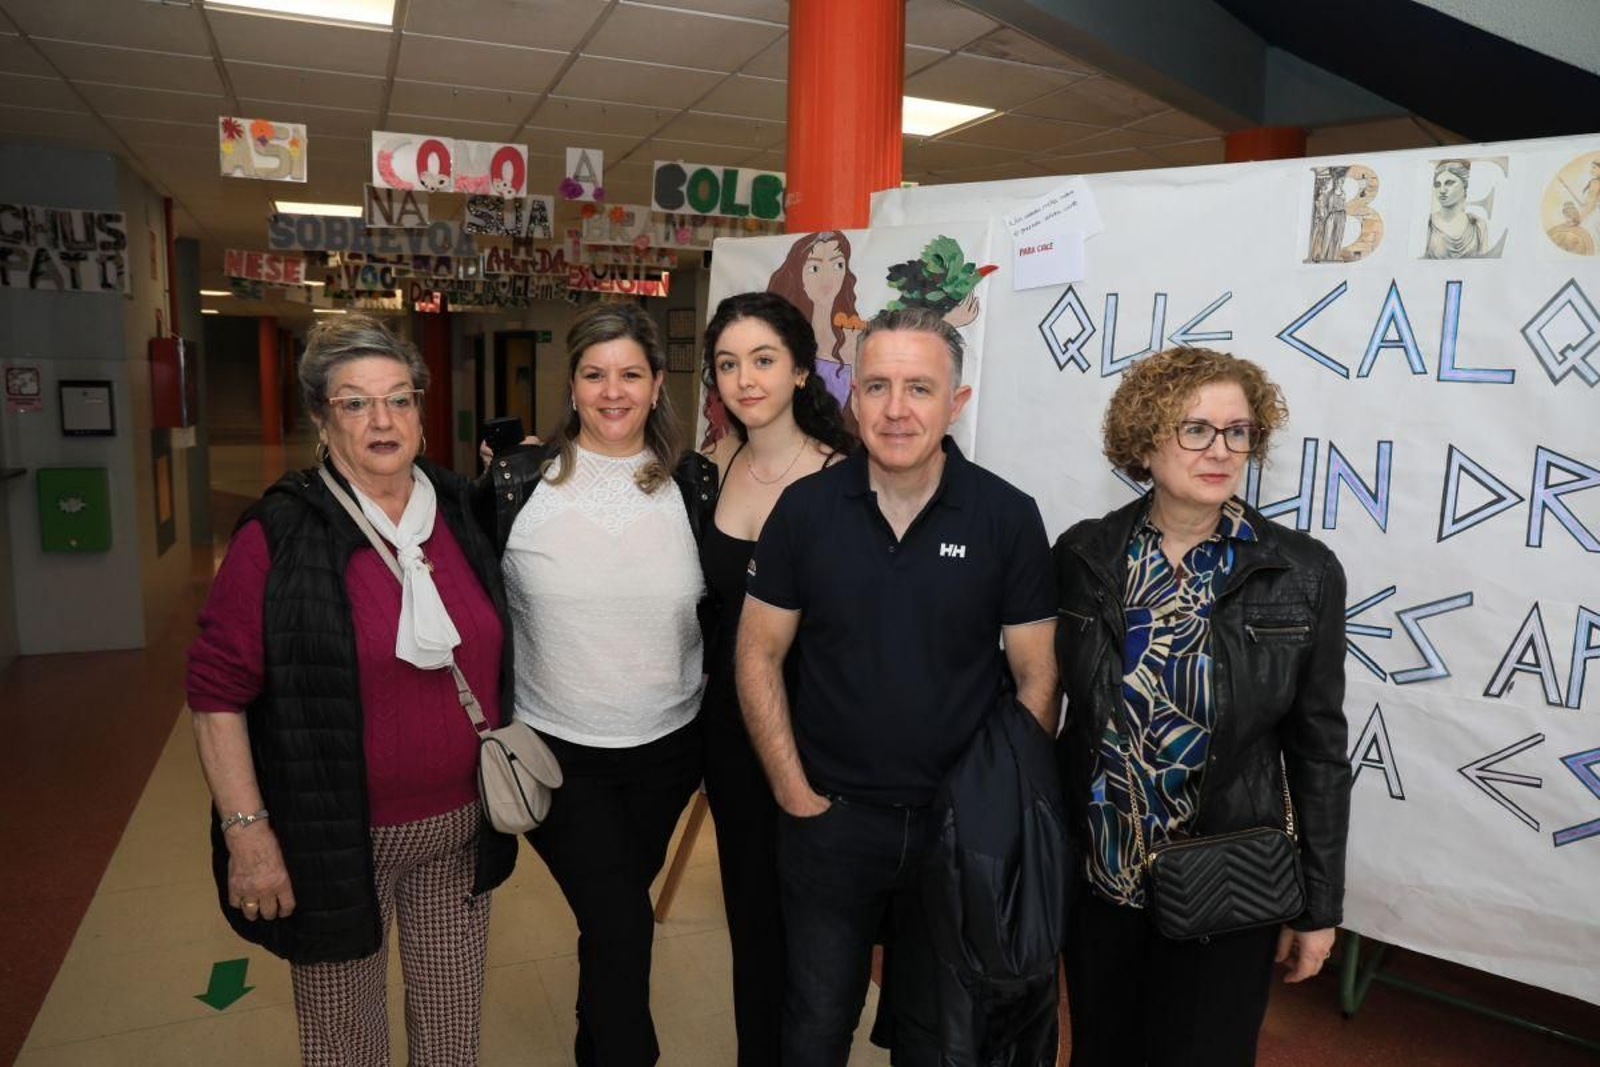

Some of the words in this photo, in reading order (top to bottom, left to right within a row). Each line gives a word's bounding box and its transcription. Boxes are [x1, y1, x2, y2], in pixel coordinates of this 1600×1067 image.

[365, 186, 428, 226] NA
[377, 138, 526, 198] COMO
[563, 149, 604, 199] A
[654, 164, 787, 218] BOLB
[225, 249, 301, 284] NESE
[1038, 284, 1233, 378] QUE
